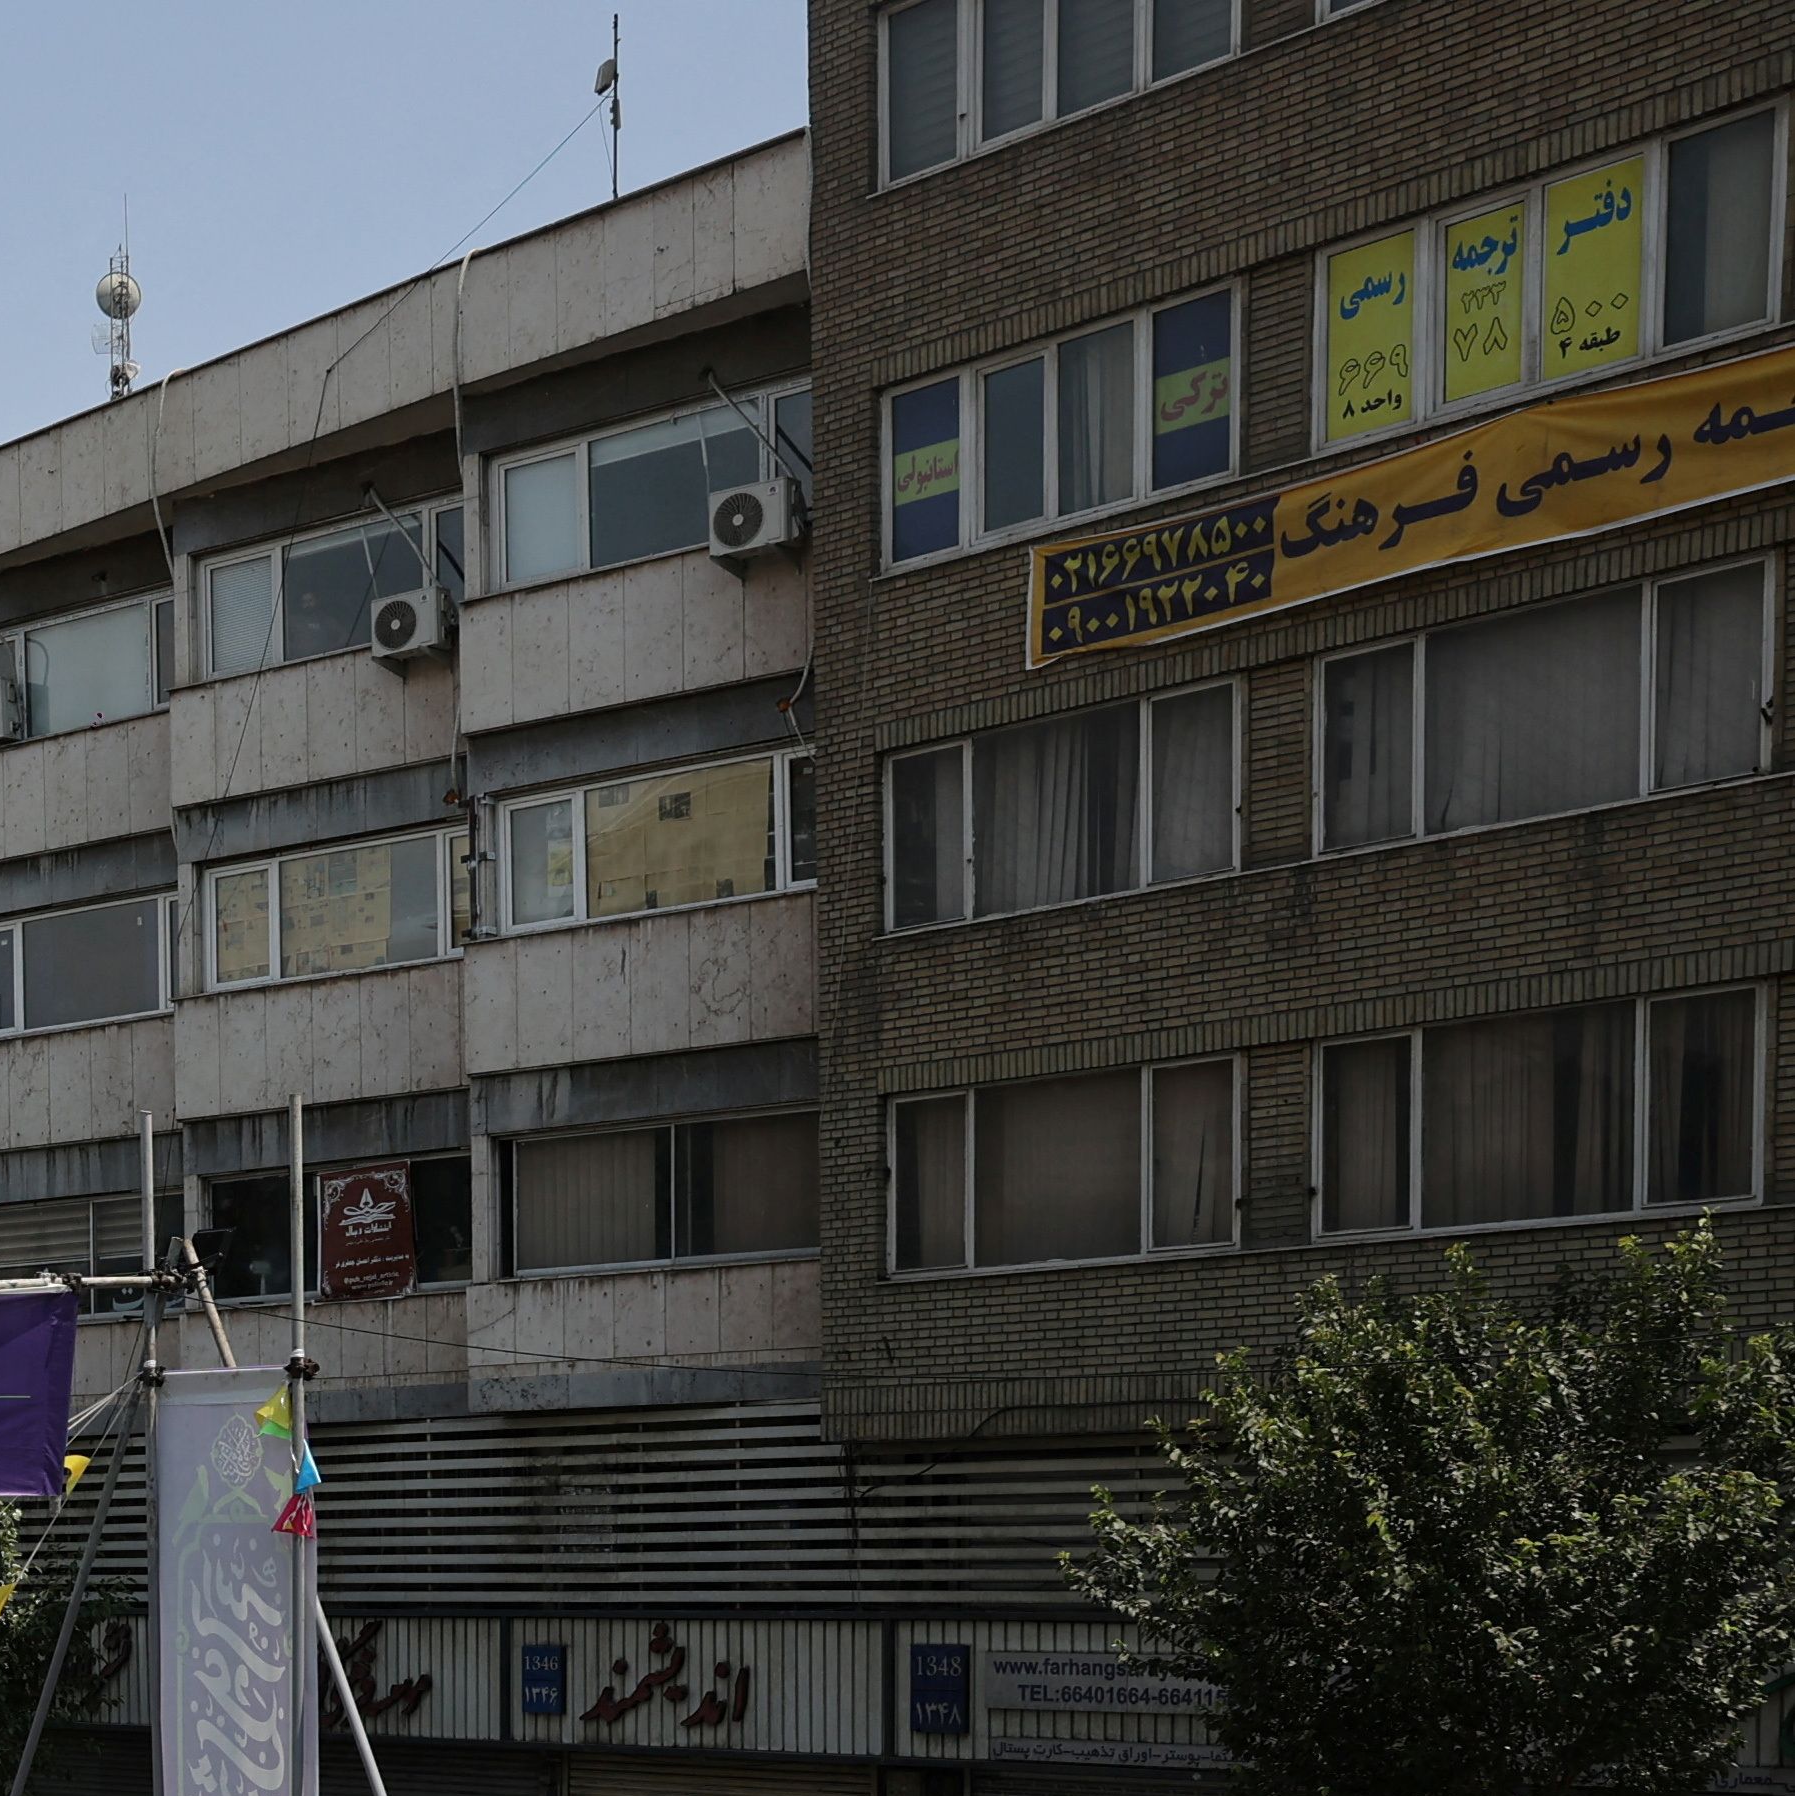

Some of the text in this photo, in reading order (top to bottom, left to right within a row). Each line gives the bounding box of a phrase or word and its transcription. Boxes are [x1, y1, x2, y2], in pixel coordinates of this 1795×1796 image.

[1340, 178, 1632, 320] دفتر ترجمه رسمی
[1339, 292, 1628, 396] ۶۶۹ ۷۸ ۵۰۰
[1342, 326, 1620, 419] طبقه ۴ واحد ۸
[897, 371, 1228, 495] ترکی استانبولی
[1280, 396, 1795, 559] مه رسمی فرهنگ
[1050, 514, 1267, 593] ۰۲۱۶۶۹۷۸۵۰۰
[1049, 560, 1266, 644] ۰۹۰۰۱۹۲۲۰۴۰
[524, 1655, 559, 1672] 1346
[524, 1686, 559, 1706] ۱۳۴۶
[579, 1622, 750, 1727] اندیشمند
[915, 1655, 962, 1677] 1348
[915, 1702, 962, 1726] ۱۳۴۸
[992, 1743, 1029, 1759] پستال
